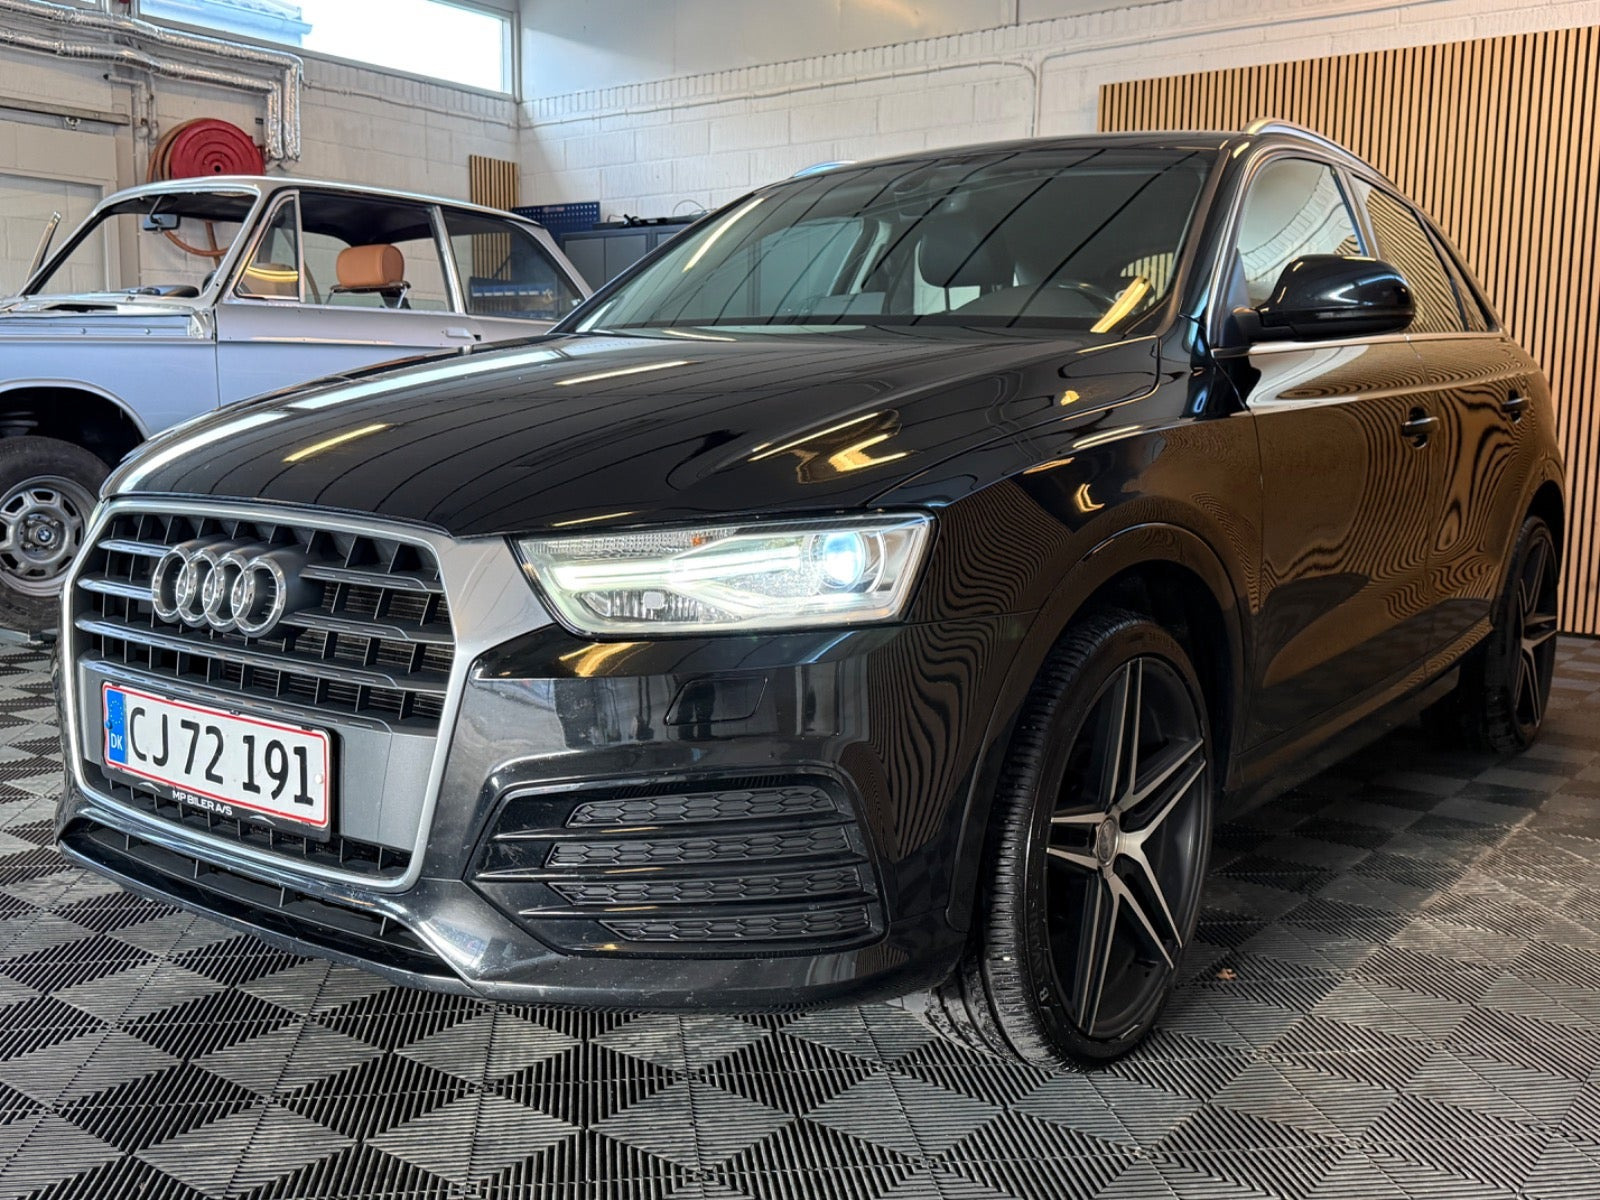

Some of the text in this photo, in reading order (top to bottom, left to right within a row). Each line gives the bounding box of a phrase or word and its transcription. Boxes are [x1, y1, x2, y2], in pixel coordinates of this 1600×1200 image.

[111, 733, 123, 751] DK
[130, 707, 313, 806] CJ 72 191
[172, 790, 233, 816] MP BILER A/S
